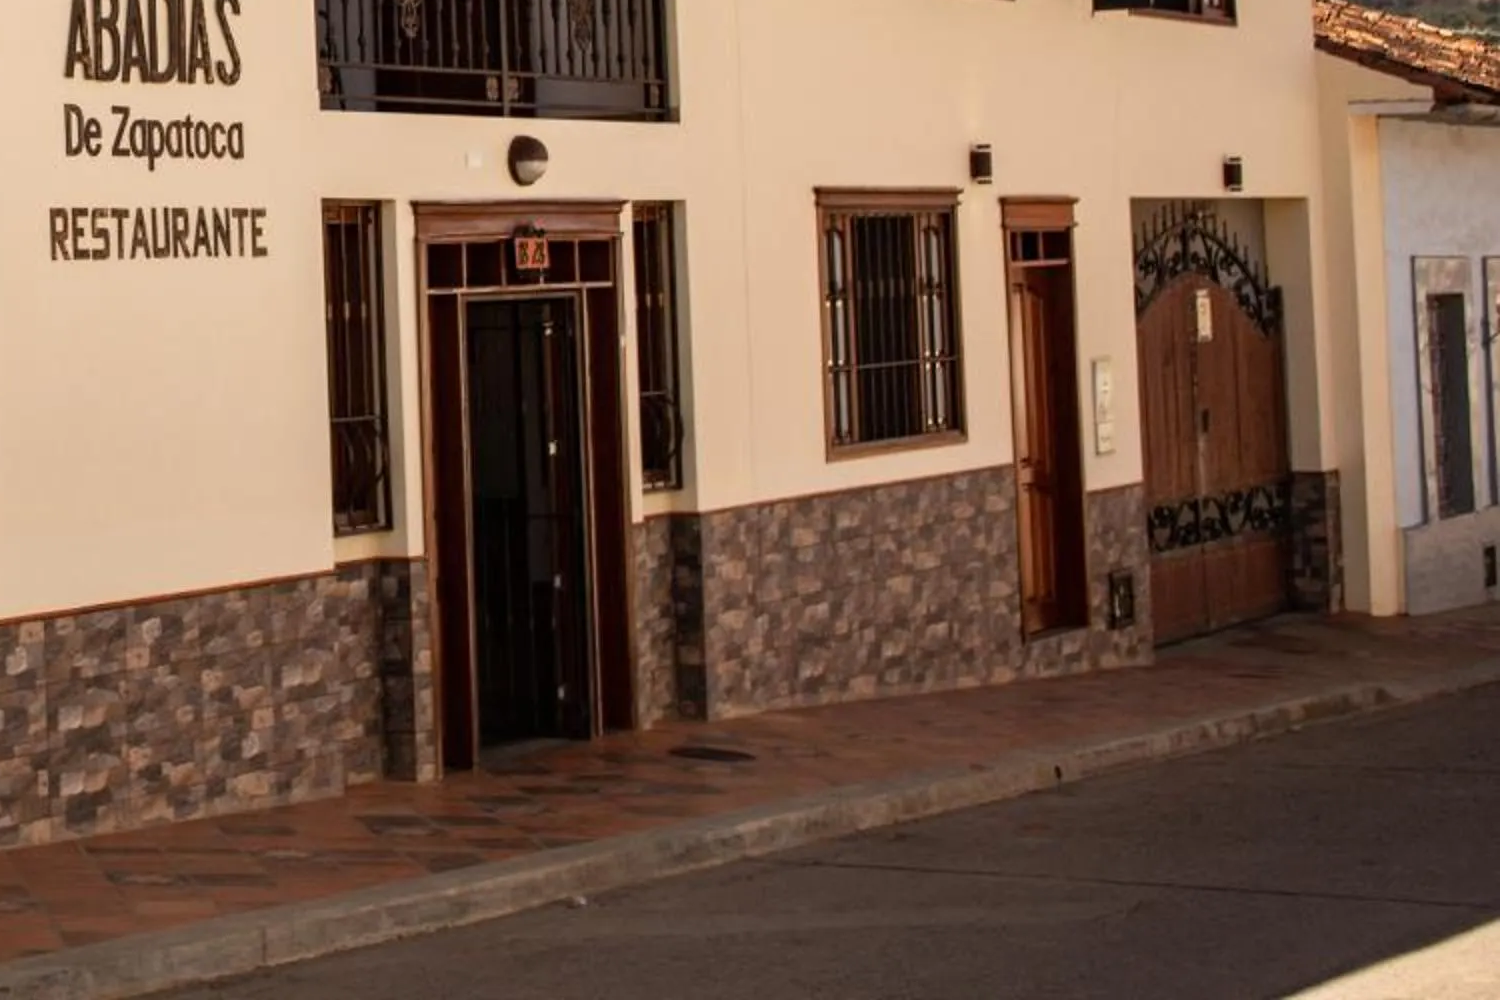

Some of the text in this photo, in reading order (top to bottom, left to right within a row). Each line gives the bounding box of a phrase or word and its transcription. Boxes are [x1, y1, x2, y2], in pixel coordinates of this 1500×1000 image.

[63, 103, 245, 172] De Zapatoca
[49, 206, 268, 261] RESTAURANTE
